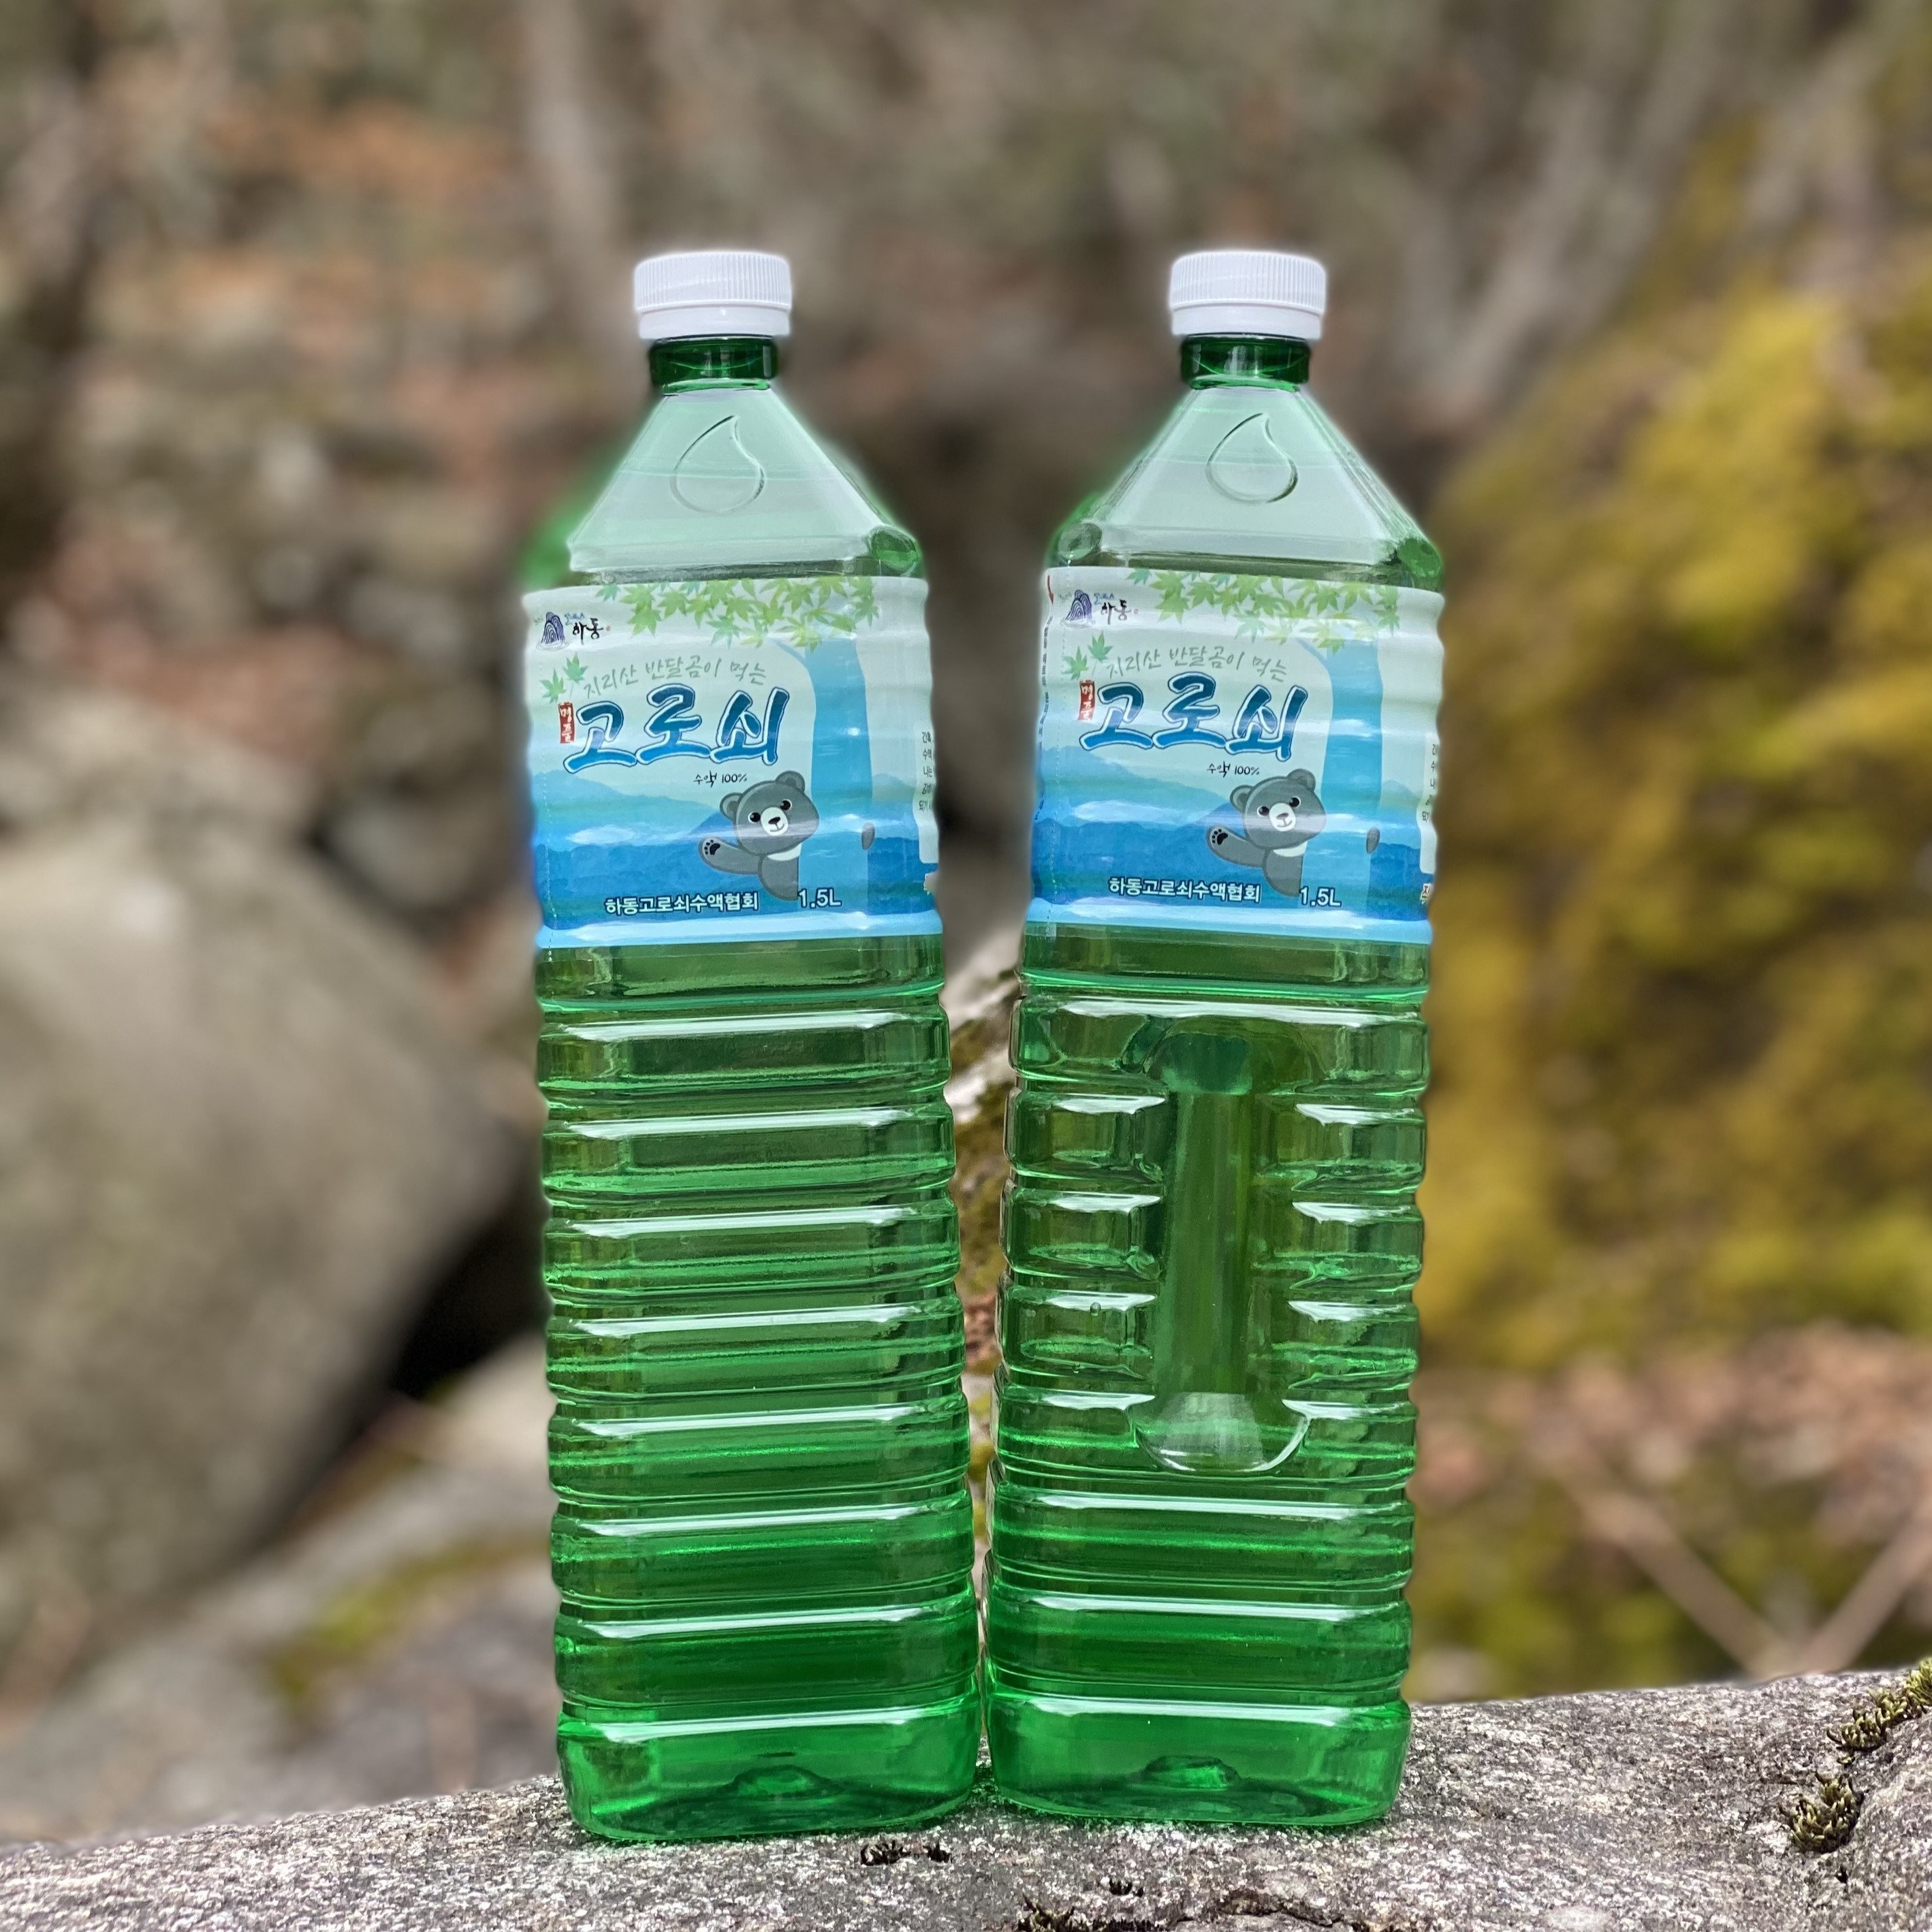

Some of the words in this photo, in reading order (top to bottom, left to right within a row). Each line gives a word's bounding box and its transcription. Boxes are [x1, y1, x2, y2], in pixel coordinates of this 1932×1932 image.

[572, 617, 604, 646] 하동
[584, 664, 639, 699] 지리산
[646, 654, 723, 680] 반달곰이
[730, 661, 766, 685] 먹는
[1106, 648, 1162, 679] 지리산
[1169, 646, 1246, 670] 반달곰이
[1252, 655, 1288, 682] 먹는
[563, 683, 790, 773] 고로쇠
[1079, 671, 1308, 761] 고로쇠
[693, 770, 717, 787] 수액
[722, 774, 747, 783] 100%
[1207, 761, 1231, 778] 수액
[1235, 765, 1259, 775] 100%
[797, 888, 842, 908] 1.5L
[1109, 877, 1261, 903] 하동고로쇠수액협회
[1299, 886, 1342, 907] 1.5L
[605, 891, 760, 916] 하동고로쇠수액협회
